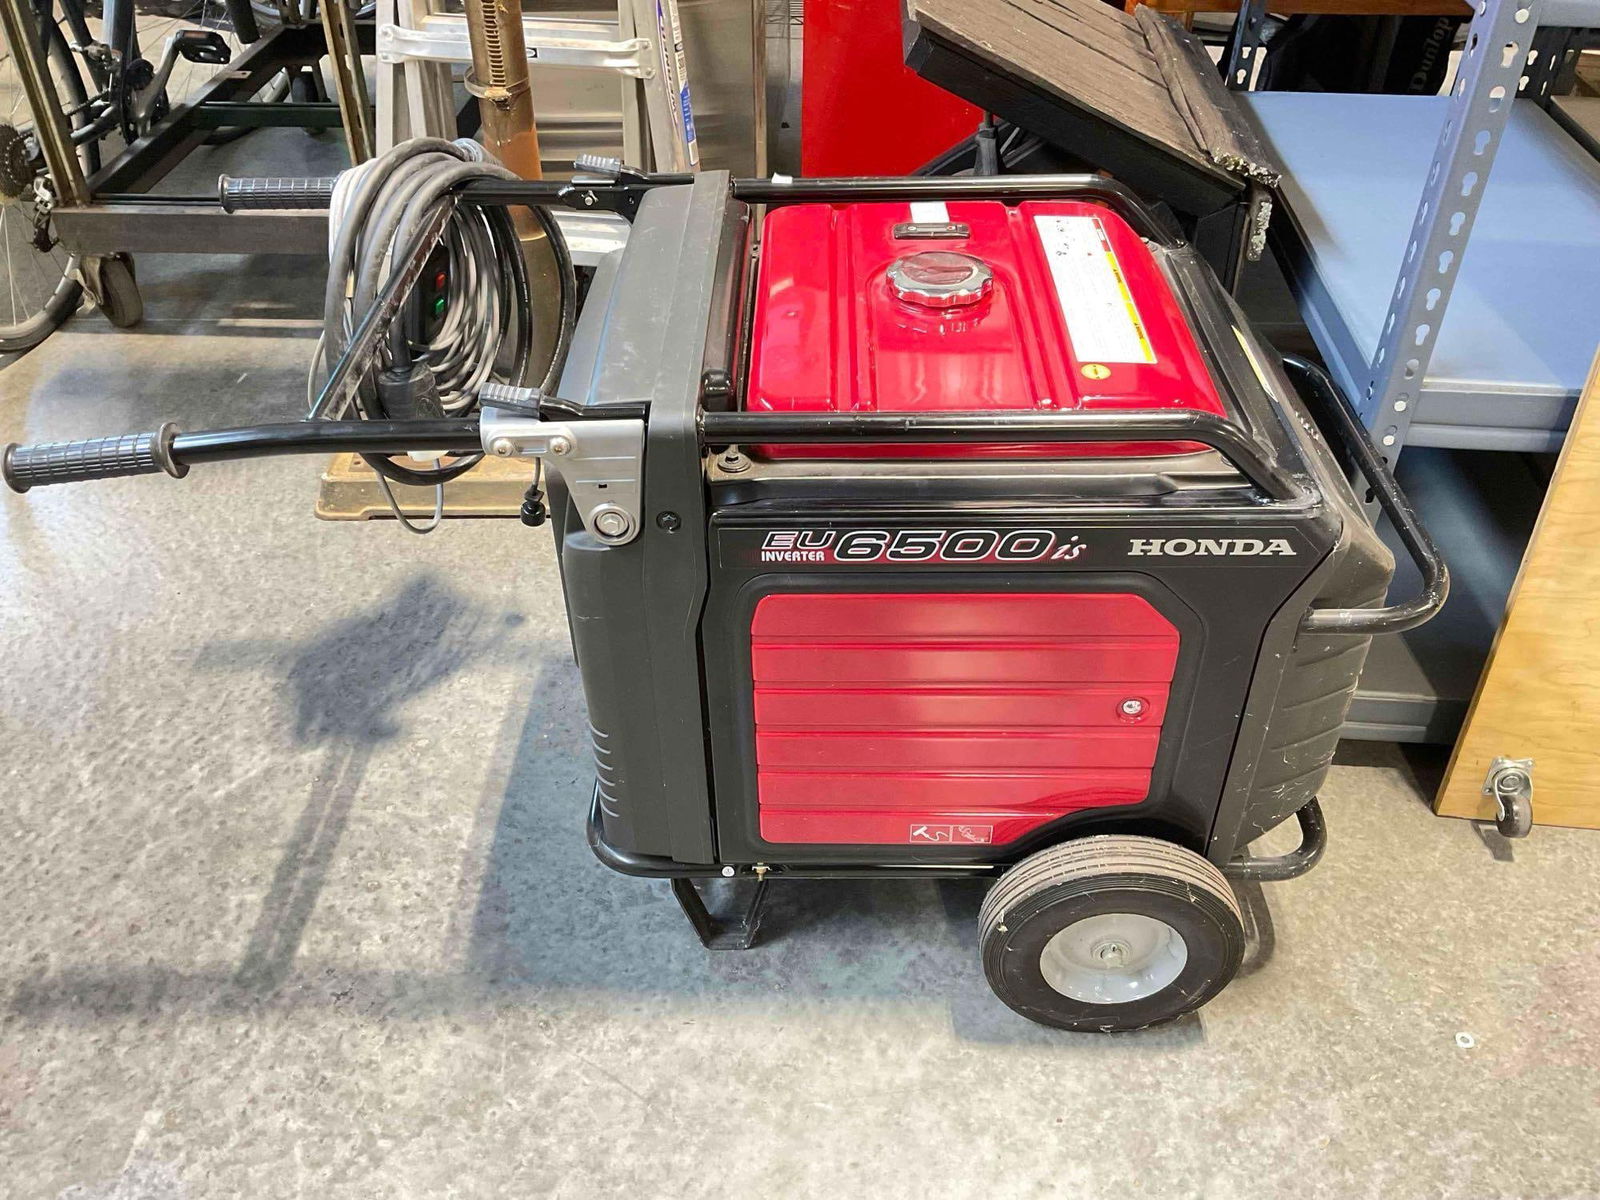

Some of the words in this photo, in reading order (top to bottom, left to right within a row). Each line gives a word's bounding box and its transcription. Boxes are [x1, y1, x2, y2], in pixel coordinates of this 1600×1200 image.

[1408, 17, 1454, 91] Dunlop
[1127, 538, 1297, 556] HONDA
[761, 551, 825, 562] INVERTER
